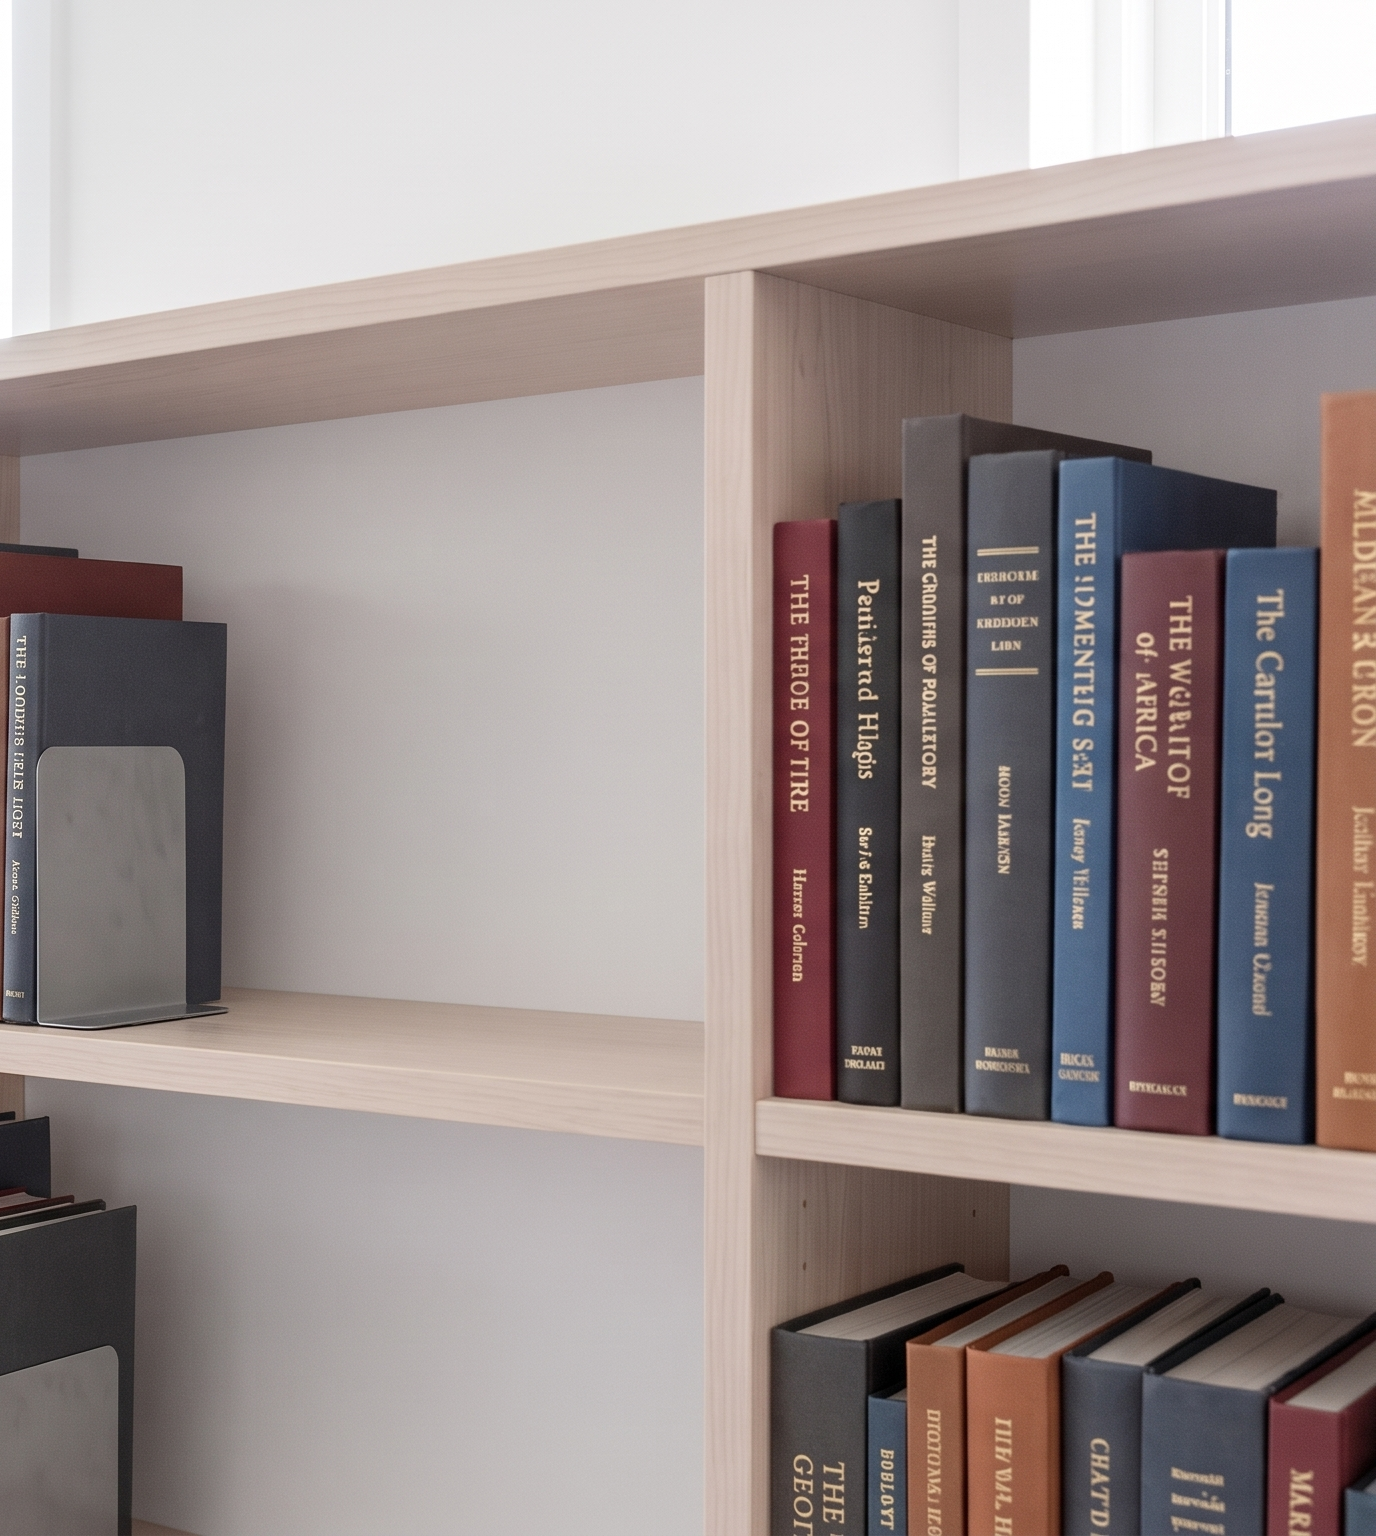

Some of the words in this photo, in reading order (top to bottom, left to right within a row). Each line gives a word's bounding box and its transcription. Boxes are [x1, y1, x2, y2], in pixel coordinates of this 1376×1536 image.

[921, 534, 938, 569] THE
[1074, 512, 1097, 567] THE
[790, 574, 810, 626] THE
[1168, 595, 1193, 652] THE
[1255, 588, 1285, 641] The
[15, 635, 27, 669] THE
[921, 653, 937, 675] OF
[789, 720, 810, 752] OF
[790, 757, 810, 813] TIRE
[1245, 770, 1282, 839] Long
[822, 1461, 845, 1524] THE
